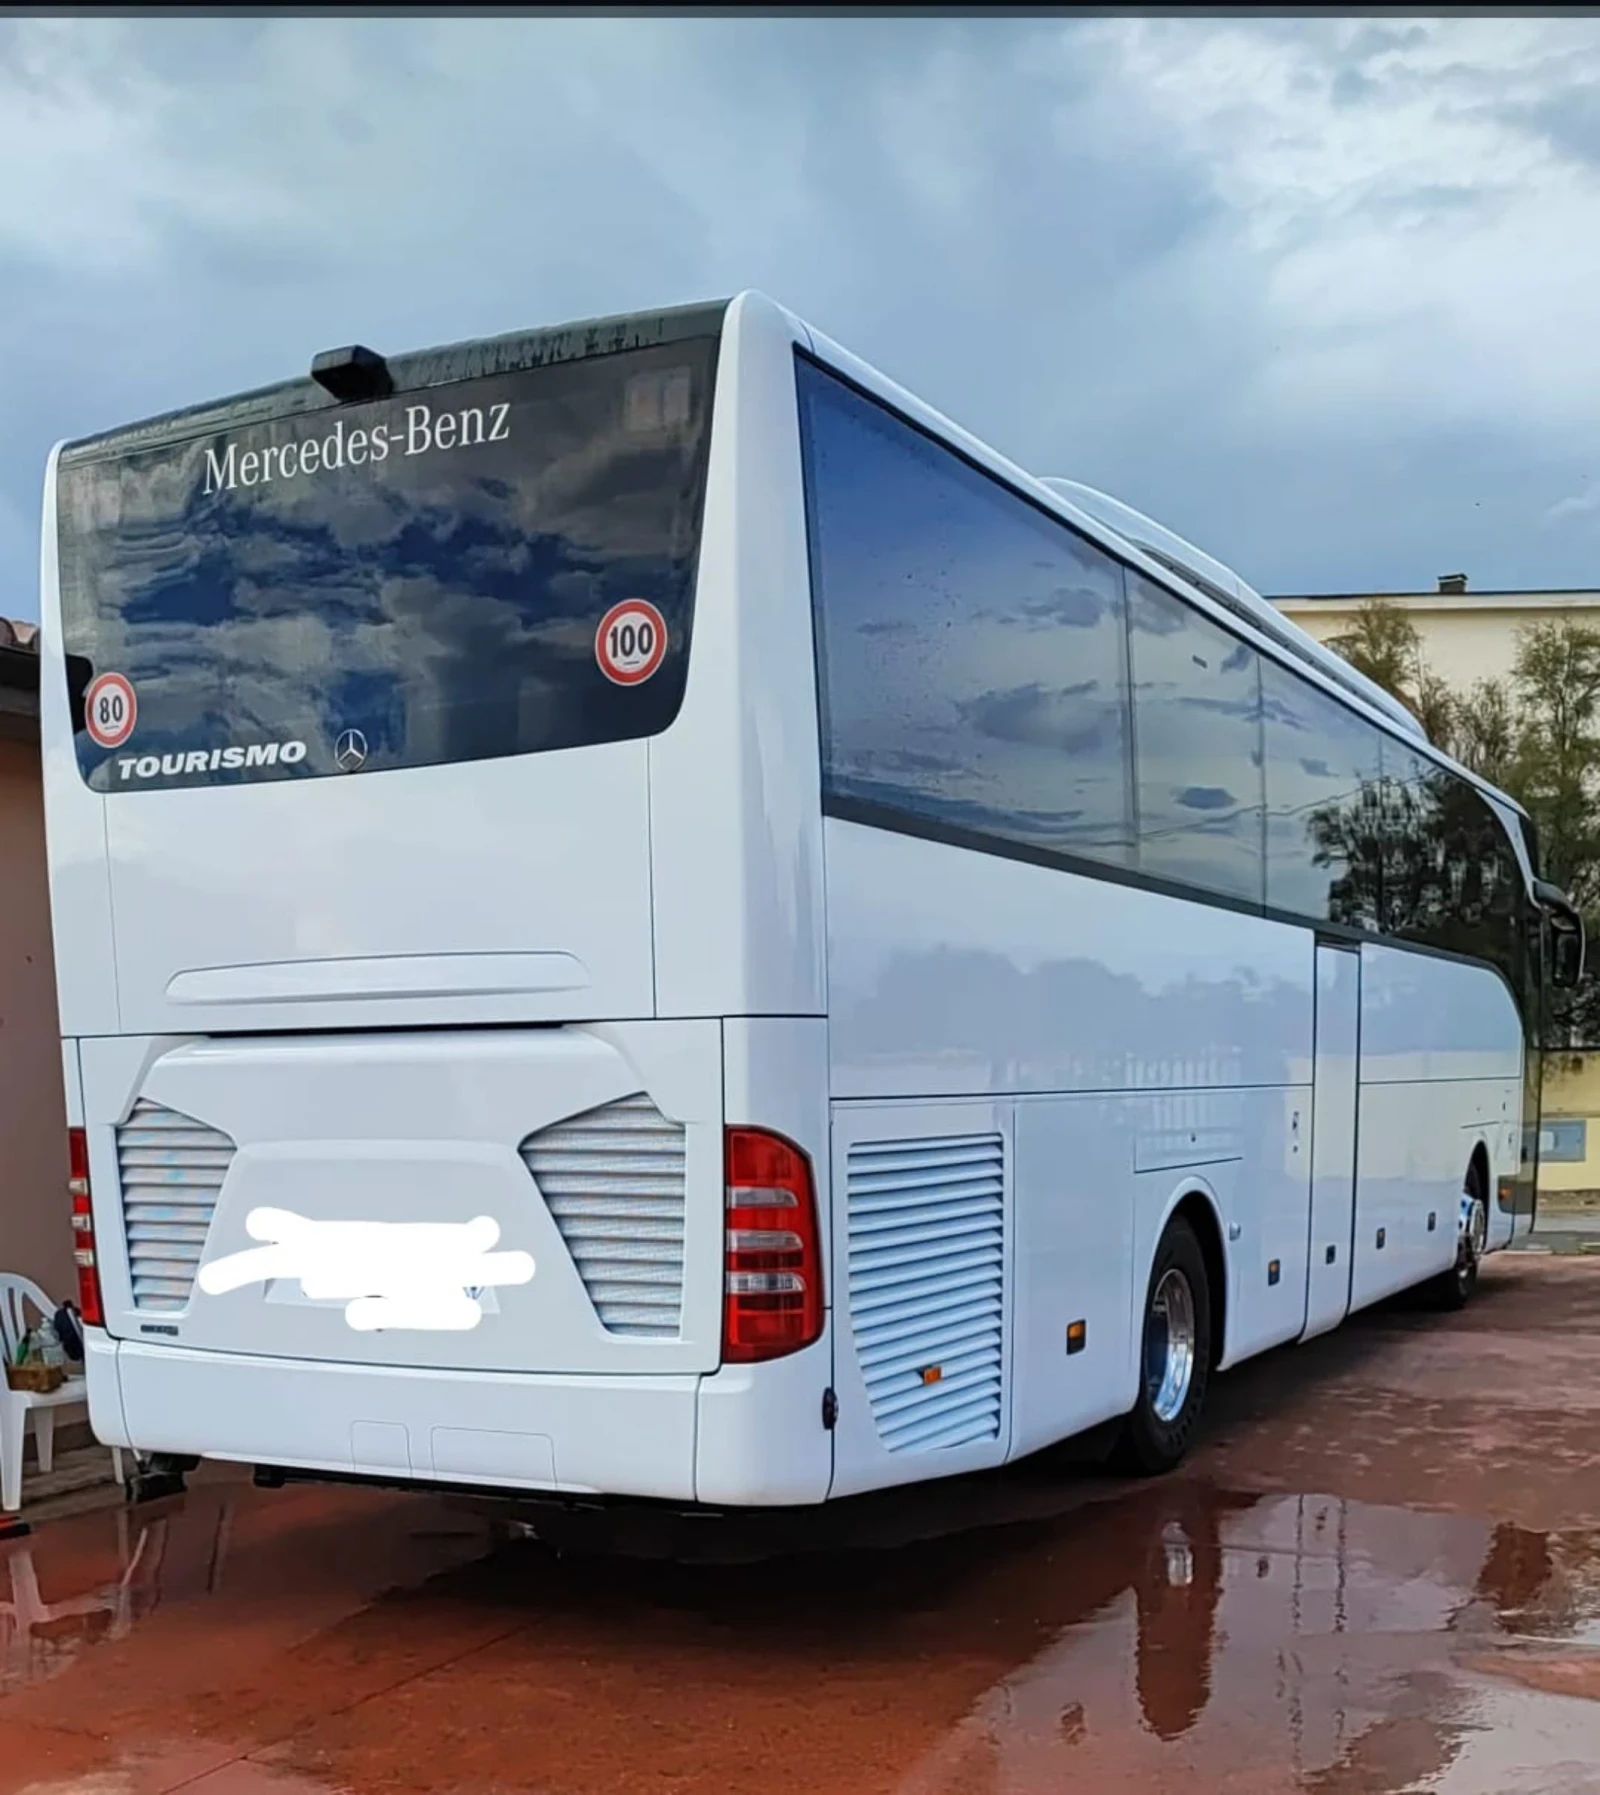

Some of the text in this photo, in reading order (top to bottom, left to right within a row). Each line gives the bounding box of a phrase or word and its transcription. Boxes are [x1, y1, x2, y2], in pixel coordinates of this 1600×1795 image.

[203, 403, 510, 494] Mercedes-Benz
[610, 622, 653, 658] 100
[100, 695, 123, 723] 80
[118, 741, 306, 780] TOURISMO
